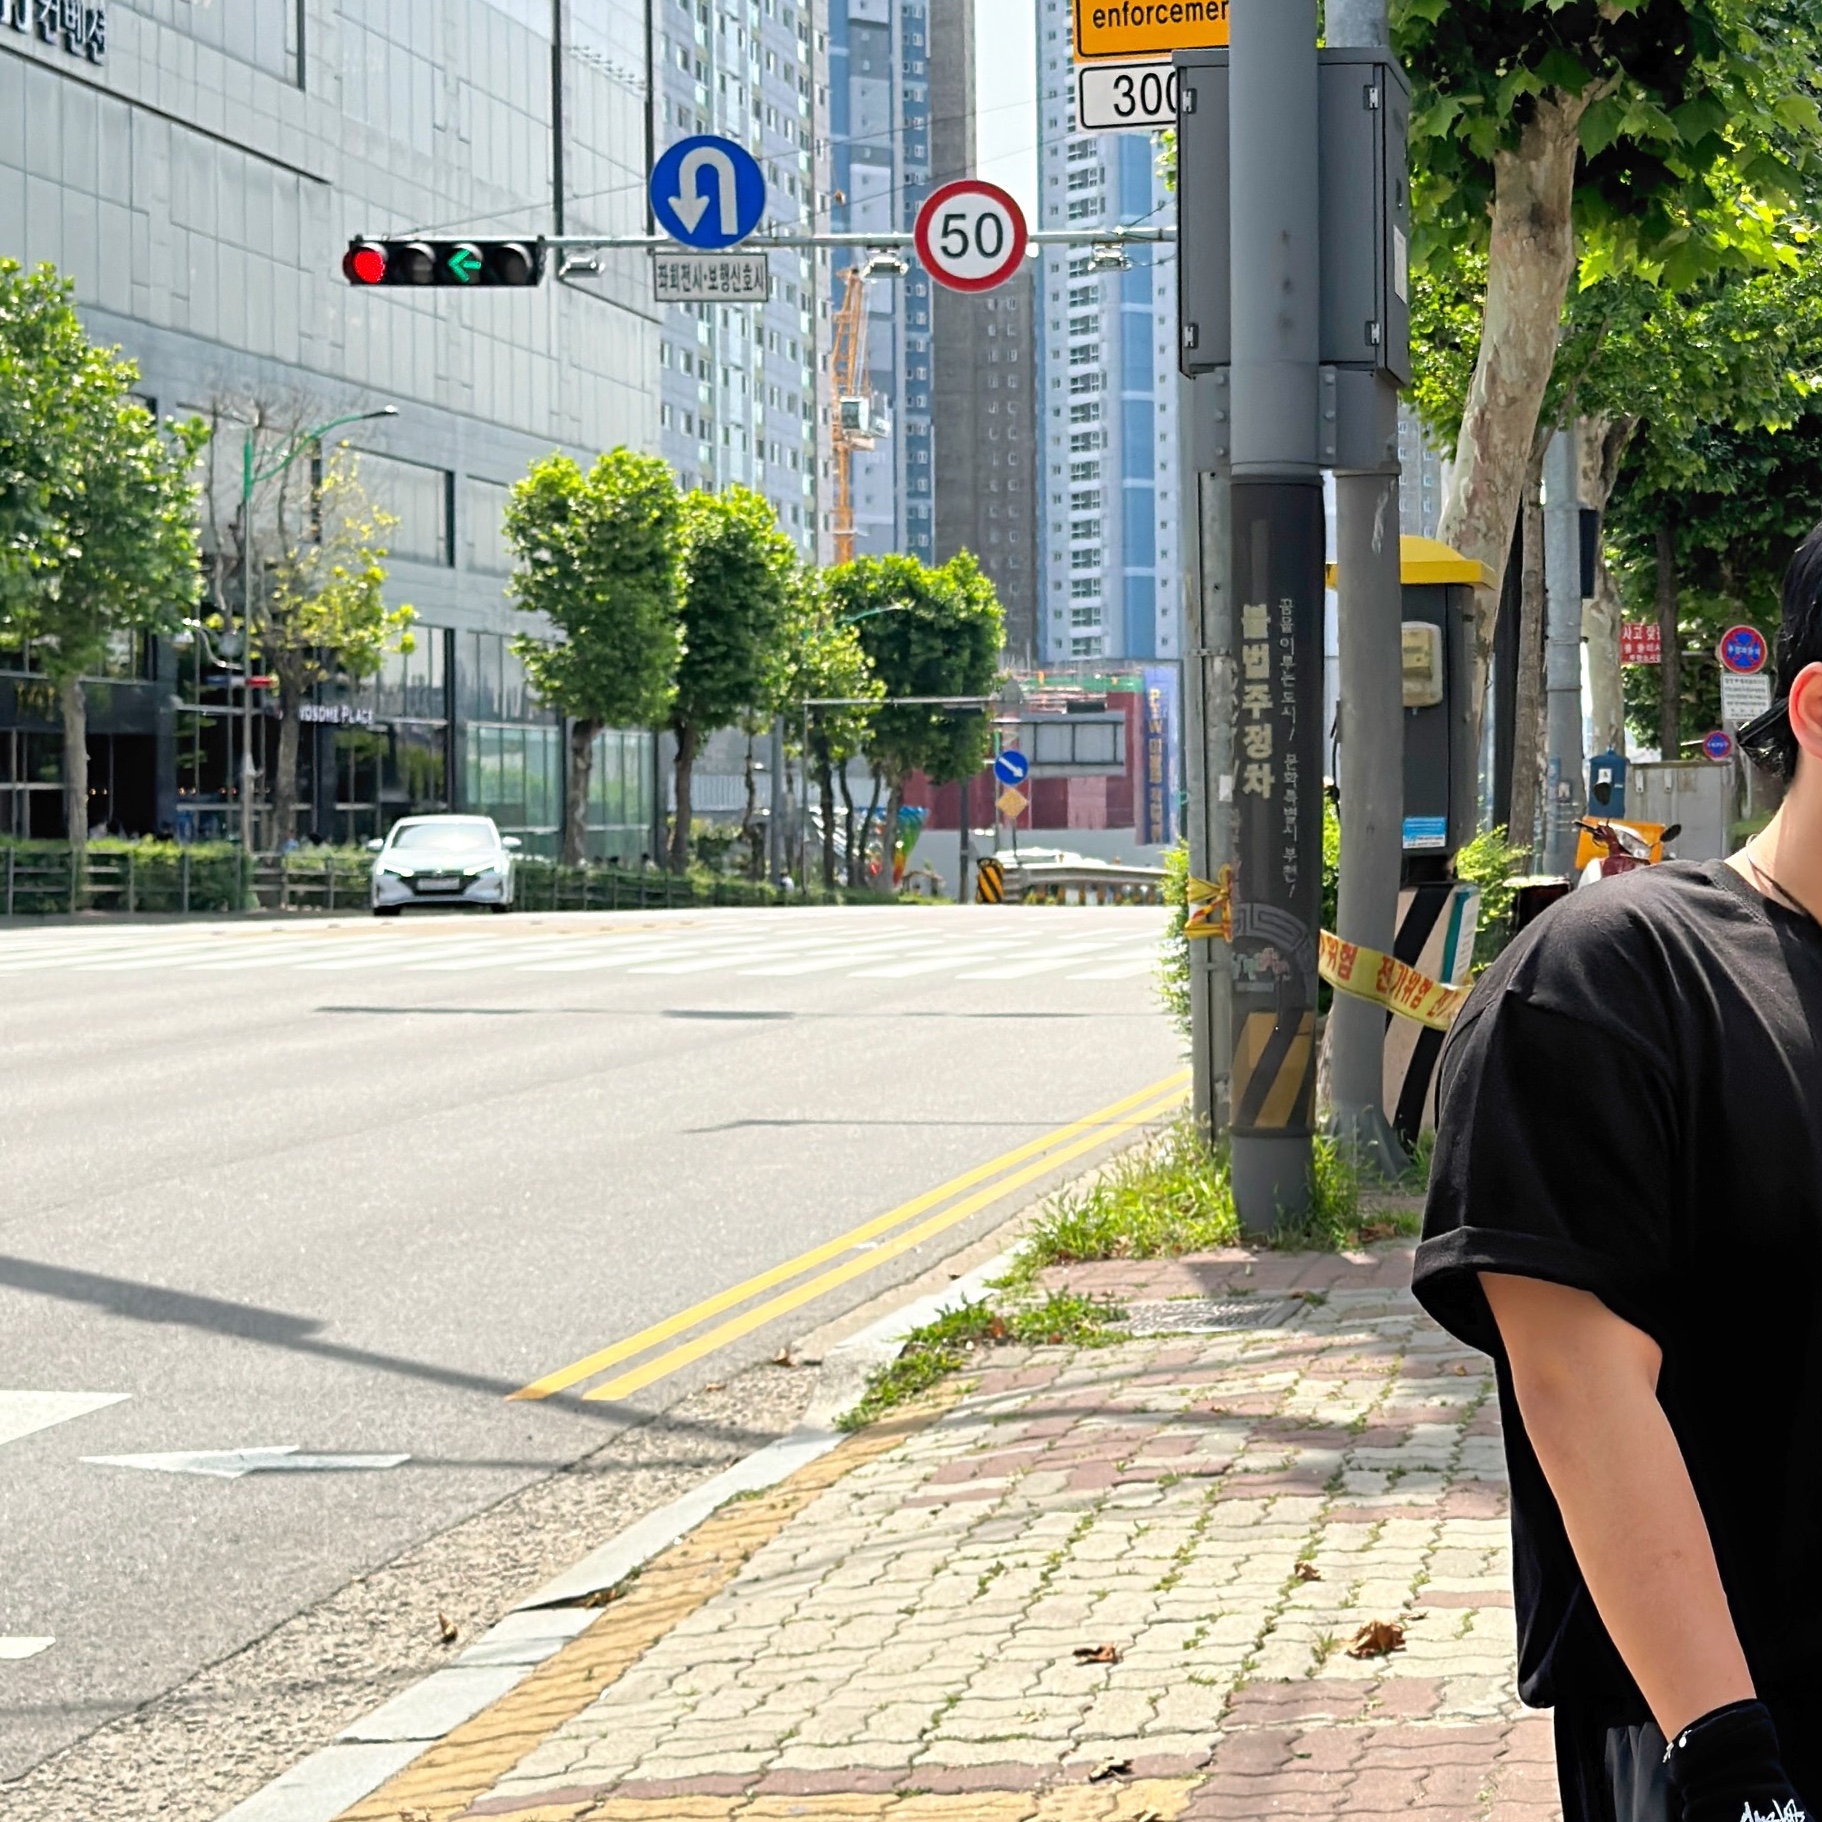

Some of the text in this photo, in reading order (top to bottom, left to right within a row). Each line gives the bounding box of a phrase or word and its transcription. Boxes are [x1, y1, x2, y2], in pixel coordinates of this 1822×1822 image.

[940, 212, 1003, 258] 50
[1241, 603, 1276, 799] 불법주정차
[1320, 933, 1359, 981] 위험
[1375, 955, 1434, 1010] 전기위험
